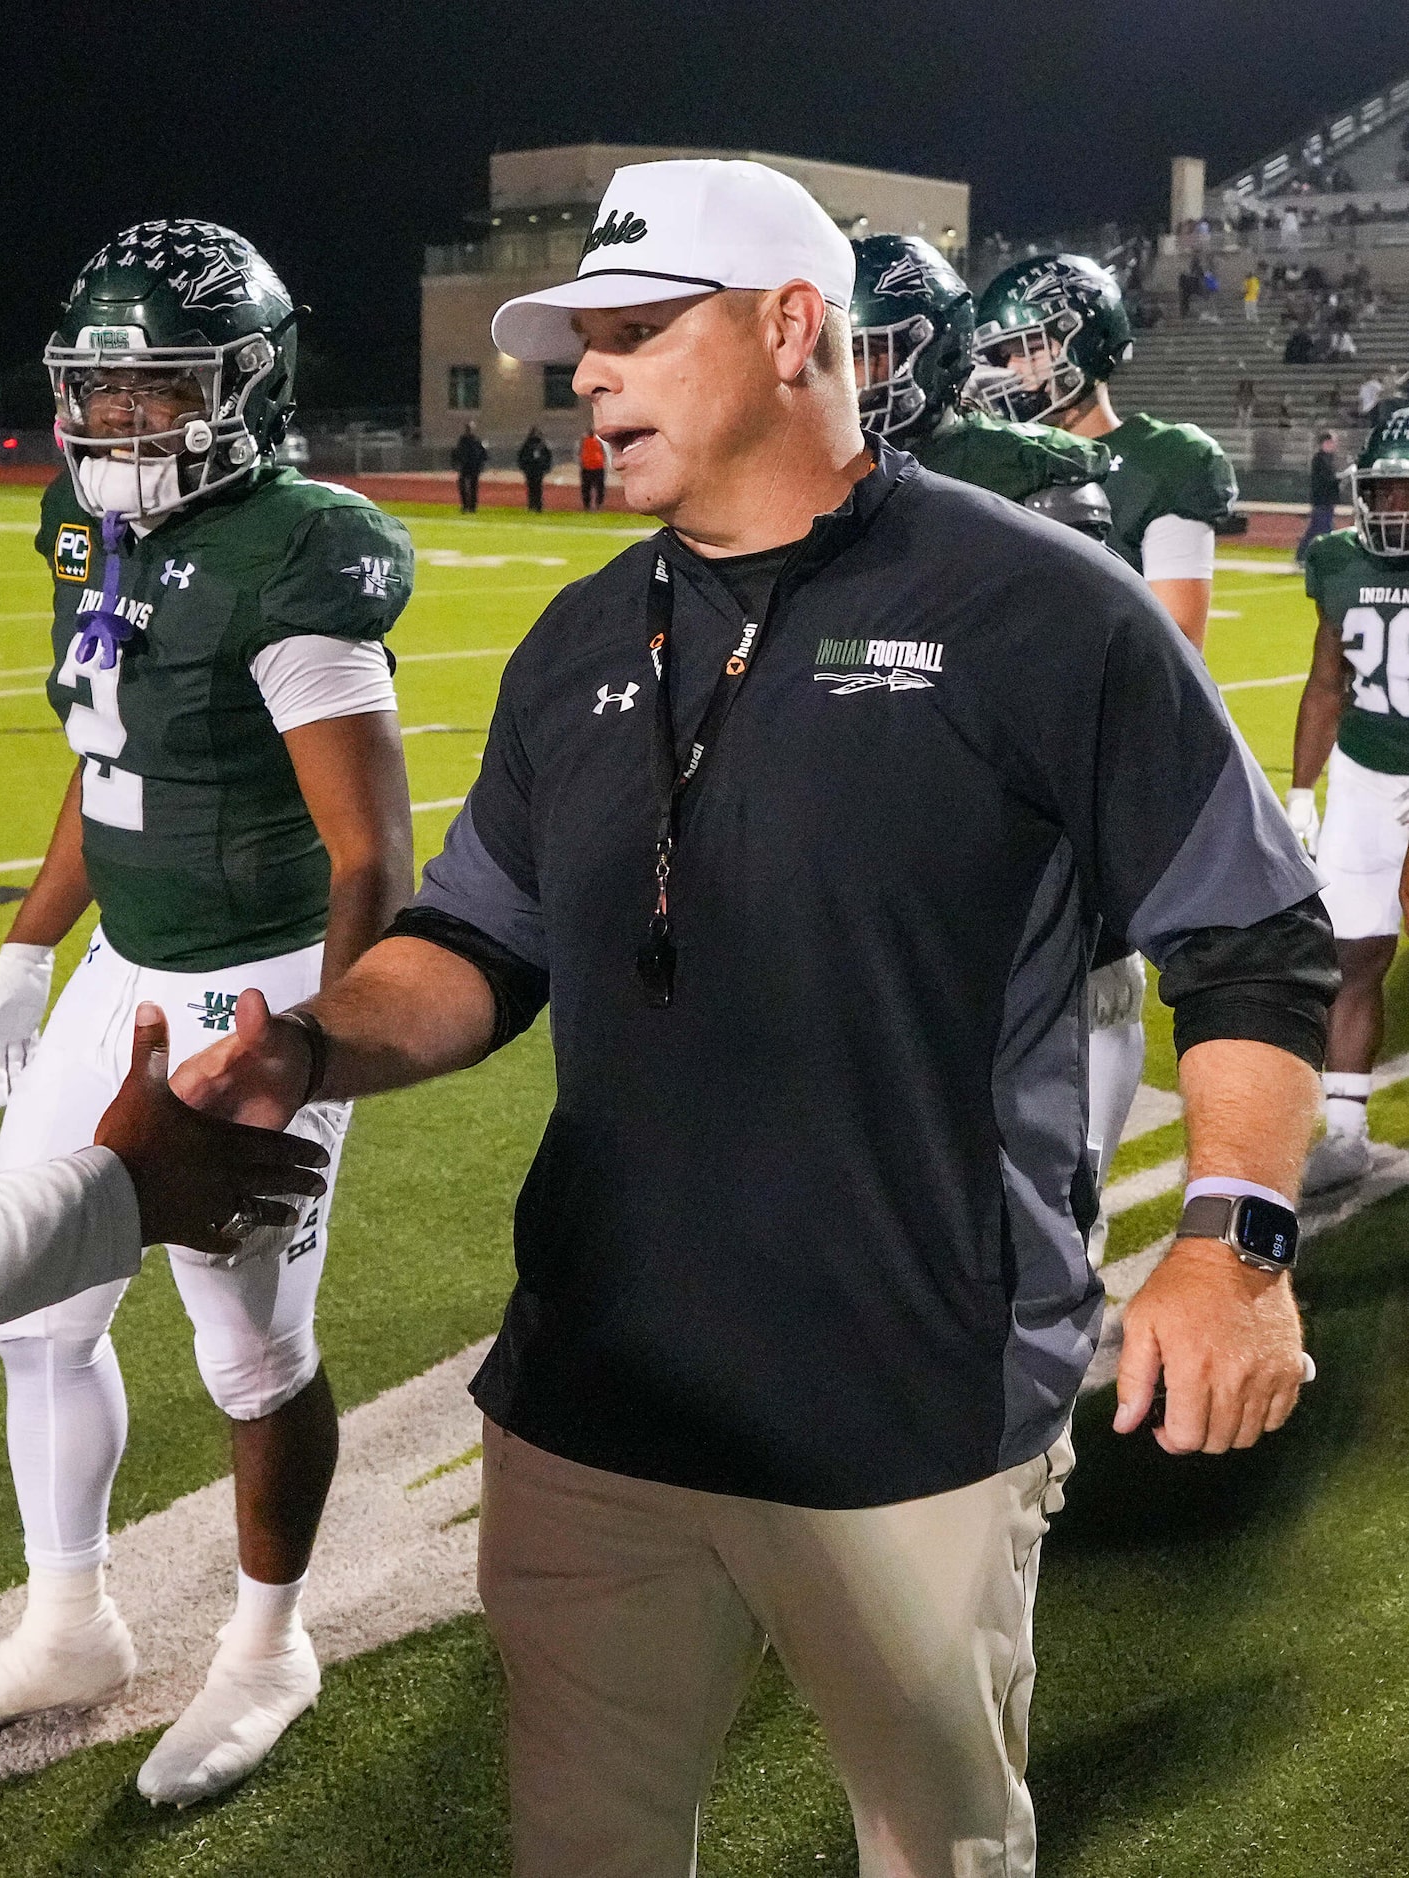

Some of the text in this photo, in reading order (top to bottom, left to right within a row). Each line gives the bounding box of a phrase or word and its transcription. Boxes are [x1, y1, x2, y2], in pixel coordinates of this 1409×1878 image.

[57, 531, 88, 560] PC
[76, 588, 154, 631] INANS
[732, 623, 759, 659] hudl
[56, 631, 144, 832] 2
[683, 742, 705, 779] hudl
